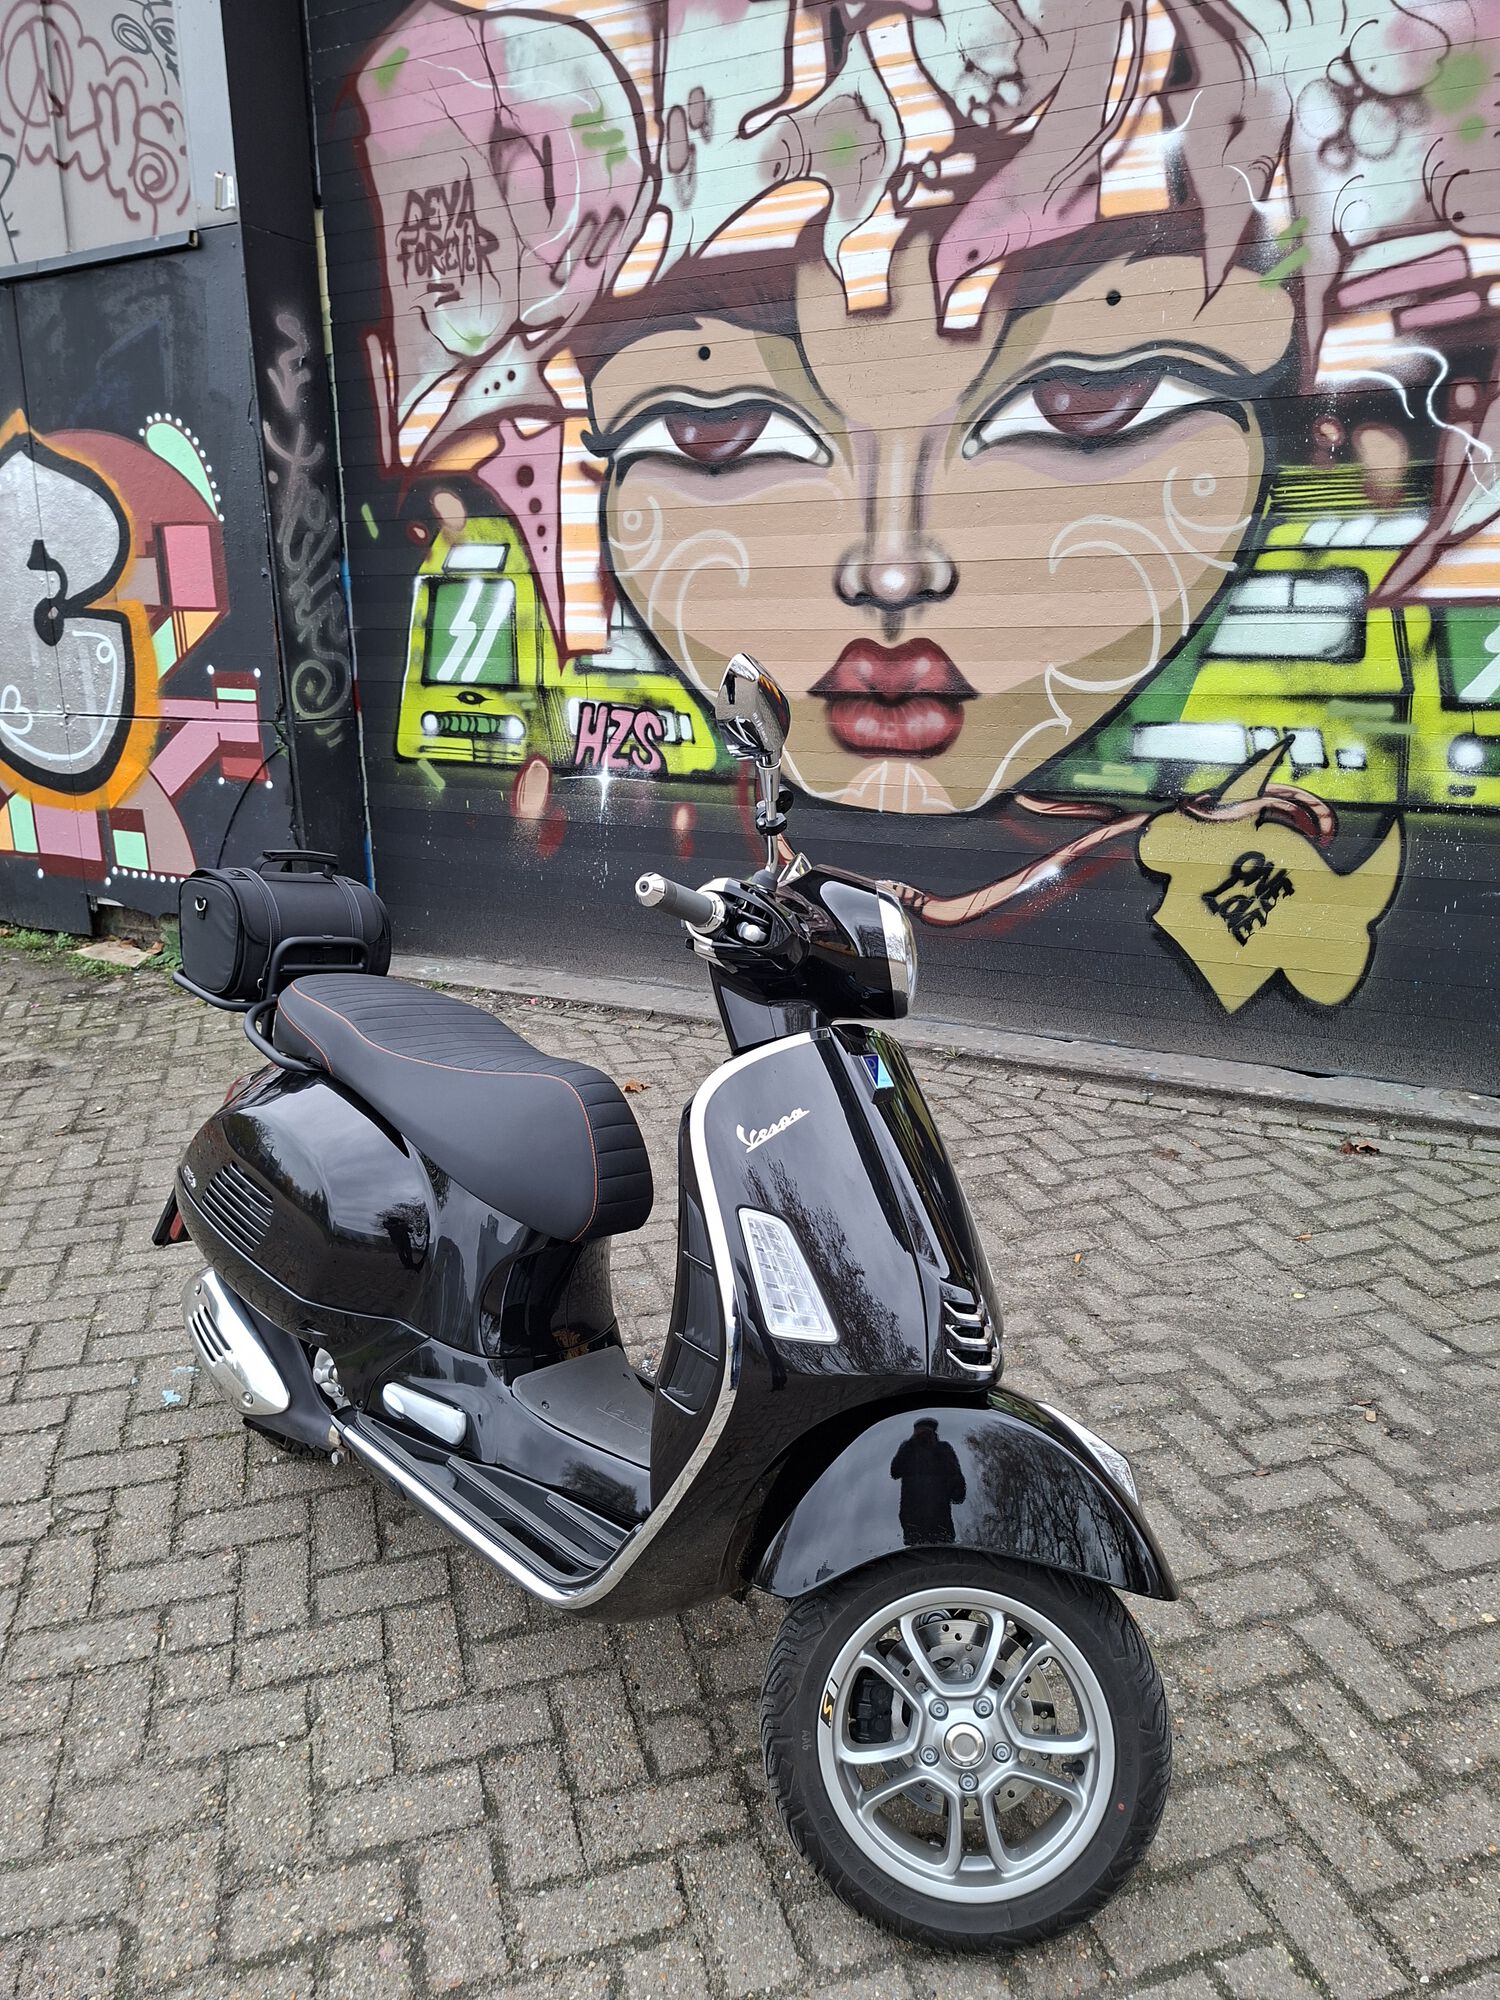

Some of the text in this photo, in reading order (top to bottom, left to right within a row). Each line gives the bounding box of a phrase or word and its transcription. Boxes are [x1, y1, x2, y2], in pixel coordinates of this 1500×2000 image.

[397, 222, 501, 292] FOREVER
[574, 703, 665, 773] HZS
[736, 1107, 810, 1154] Vespa
